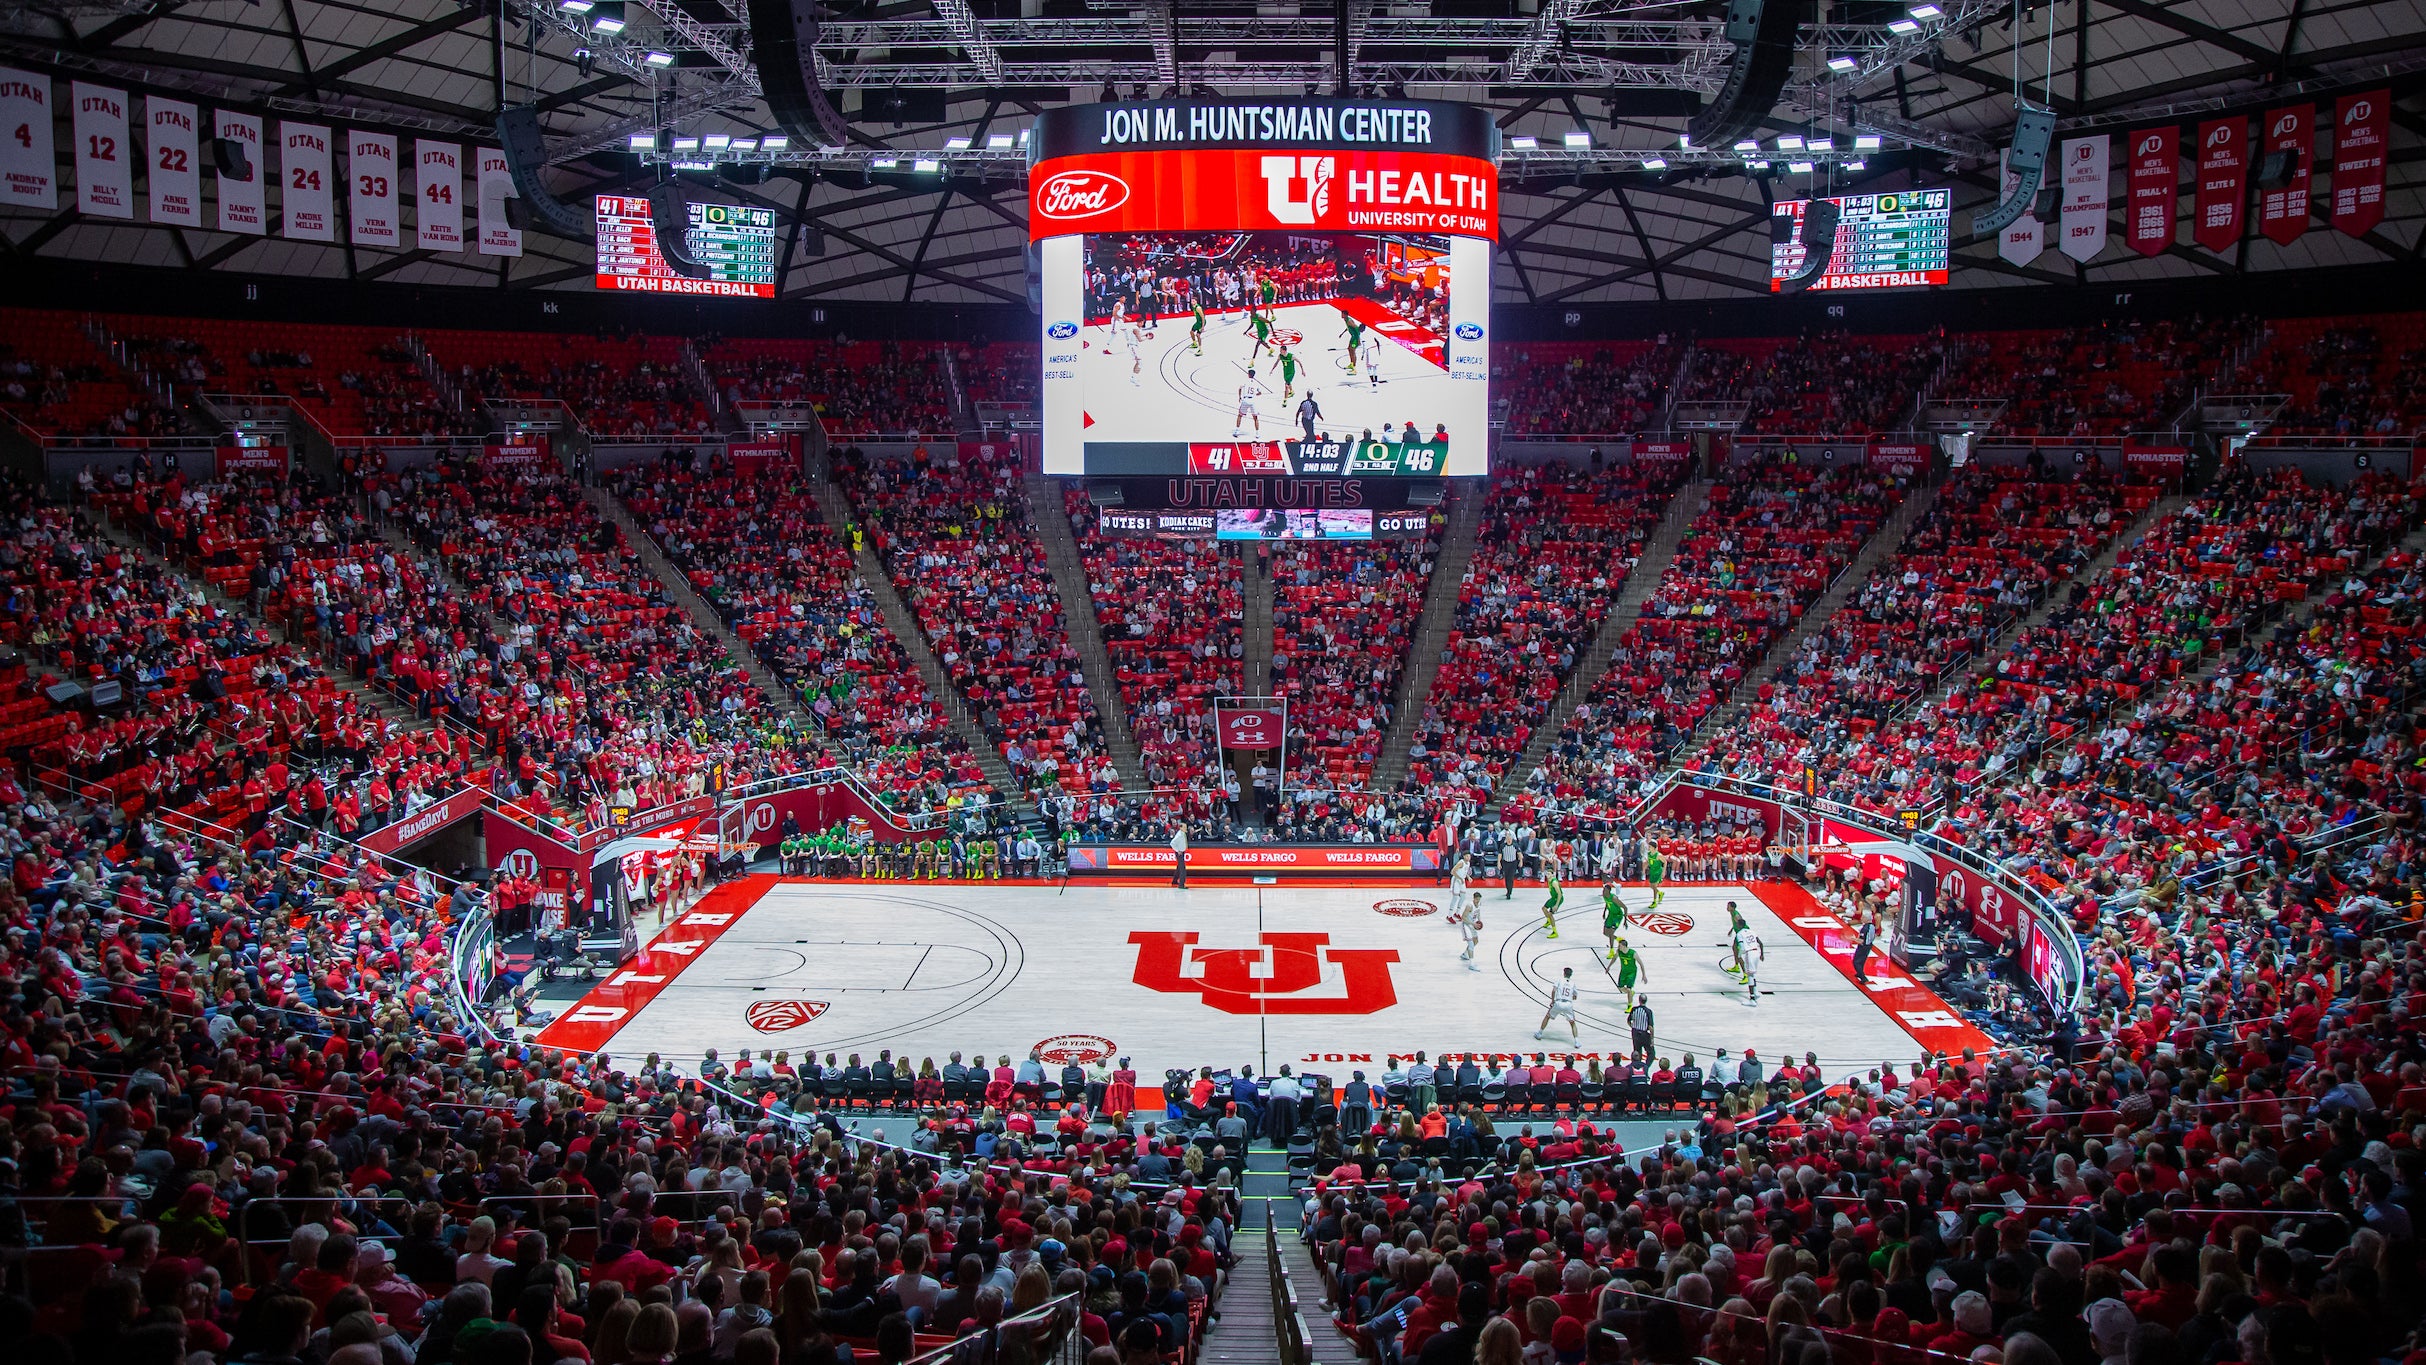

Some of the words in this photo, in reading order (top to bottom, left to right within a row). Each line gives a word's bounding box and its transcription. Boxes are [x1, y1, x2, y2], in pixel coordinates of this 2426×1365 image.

[1, 82, 44, 105] UTAH
[82, 98, 121, 119] UTAH
[156, 111, 191, 132] UTAH
[1102, 107, 1148, 144] JON
[1155, 107, 1184, 141] M.
[1190, 105, 1333, 142] HUNTSMAN
[1340, 107, 1433, 144] CENTER
[15, 123, 32, 148] 4
[224, 124, 256, 144] UTAH
[2351, 127, 2371, 138] MEN'S
[90, 135, 116, 161] 12
[290, 135, 324, 153] UTAH
[2279, 139, 2297, 150] MEN'S
[2340, 136, 2380, 149] BASKETBALL
[357, 144, 391, 161] UTAH
[2213, 151, 2230, 159] MEN'S
[159, 147, 188, 172] 22
[424, 152, 456, 169] UTAH
[2143, 159, 2162, 168] MEN'S
[2203, 158, 2239, 170] BASKETBALL
[2338, 160, 2370, 171] SWEET
[2371, 157, 2381, 167] 16
[485, 160, 512, 172] UTA
[2135, 165, 2171, 177] BASKETBALL
[5, 173, 48, 186] ANDREW
[293, 168, 321, 190] 24
[2068, 174, 2101, 184] BASKETBALL
[2205, 181, 2229, 190] ELITE
[2230, 179, 2236, 188] 8
[12, 184, 42, 196] BOGUT
[93, 185, 118, 195] BILLY
[360, 176, 388, 198] 33
[1348, 169, 1487, 210] HEALTH
[2136, 188, 2160, 198] FINAL
[2161, 187, 2168, 196] 4
[164, 195, 188, 205] ARNIE
[427, 184, 452, 204] 44
[1046, 177, 1108, 213] Ford
[1846, 197, 1872, 207] 14:03
[1925, 193, 1944, 208] 46
[162, 204, 190, 215] FERRIN
[229, 204, 256, 214] DANNY
[600, 199, 619, 215] 41
[2062, 203, 2106, 213] CHAMPIONS
[2139, 205, 2164, 217] 1961
[2207, 202, 2233, 215] 1956
[228, 213, 258, 224] VRANES
[296, 213, 323, 222] ANDRE
[366, 219, 386, 228] VERN
[751, 211, 770, 226] 46
[1348, 211, 1435, 227] UNIVERSITY
[1439, 213, 1457, 228] OF
[1460, 215, 1486, 231] UTAH
[2138, 216, 2165, 229] 1966
[2206, 215, 2232, 228] 1997
[296, 221, 324, 231] MILLER
[359, 227, 393, 237] GARDNER
[431, 225, 452, 234] KEITH
[2071, 226, 2095, 237] 1947
[423, 233, 439, 241] VAN
[441, 234, 460, 243] HORN
[493, 231, 509, 239] RICK
[2010, 232, 2032, 243] 1944
[2138, 228, 2165, 240] 1998
[485, 238, 517, 248] MAJERUS
[1831, 271, 1930, 288] BASKETBALL
[246, 283, 257, 300] jj
[617, 277, 658, 290] UTAH
[662, 279, 759, 296] BASKETBALL
[2114, 293, 2131, 305] rr
[543, 302, 559, 314] kk
[1827, 304, 1844, 317] qq
[1565, 312, 1581, 324] pp
[1052, 323, 1074, 338] Ford
[1459, 324, 1479, 338] Ford
[1049, 354, 1077, 364] AMERICA'S
[1455, 356, 1482, 364] AMERICA'S
[1451, 371, 1486, 381] BEST-SELLING
[242, 449, 270, 459] MEN'S
[500, 447, 538, 456] WOMEN'S
[1299, 444, 1340, 459] 14:03
[1647, 444, 1671, 453] MEN'S
[1878, 446, 1917, 455] WOMEN'S
[1207, 447, 1232, 470] 41
[1404, 448, 1436, 471] 46
[1824, 450, 1833, 460] Q
[1872, 455, 1924, 463] BASKETBALL
[2075, 452, 2084, 463] R
[2127, 453, 2184, 462] GYMNASTICS
[2358, 455, 2367, 467] S
[165, 455, 175, 468] H
[1303, 463, 1319, 473] 2ND
[1320, 463, 1339, 473] HALF
[1168, 479, 1264, 507] UTAH
[1274, 479, 1363, 507] UTES
[1112, 517, 1151, 529] UTES!
[1160, 516, 1186, 528] KODIAK
[1188, 517, 1212, 530] CAKES
[1379, 518, 1401, 530] GO
[616, 816, 625, 825] 18
[642, 814, 655, 826] THE
[656, 809, 674, 821] MUSS
[1901, 811, 1919, 820] 14:03
[1117, 853, 1153, 862] WELLS
[1156, 853, 1192, 862] FARO
[1221, 853, 1258, 862] WELLS
[1261, 853, 1296, 862] FARGO
[1326, 853, 1362, 862] WELLS
[1365, 853, 1401, 862] FARGO
[1562, 987, 1570, 997] 15
[1301, 1053, 1372, 1062] JON
[1681, 1070, 1700, 1080] UTES
